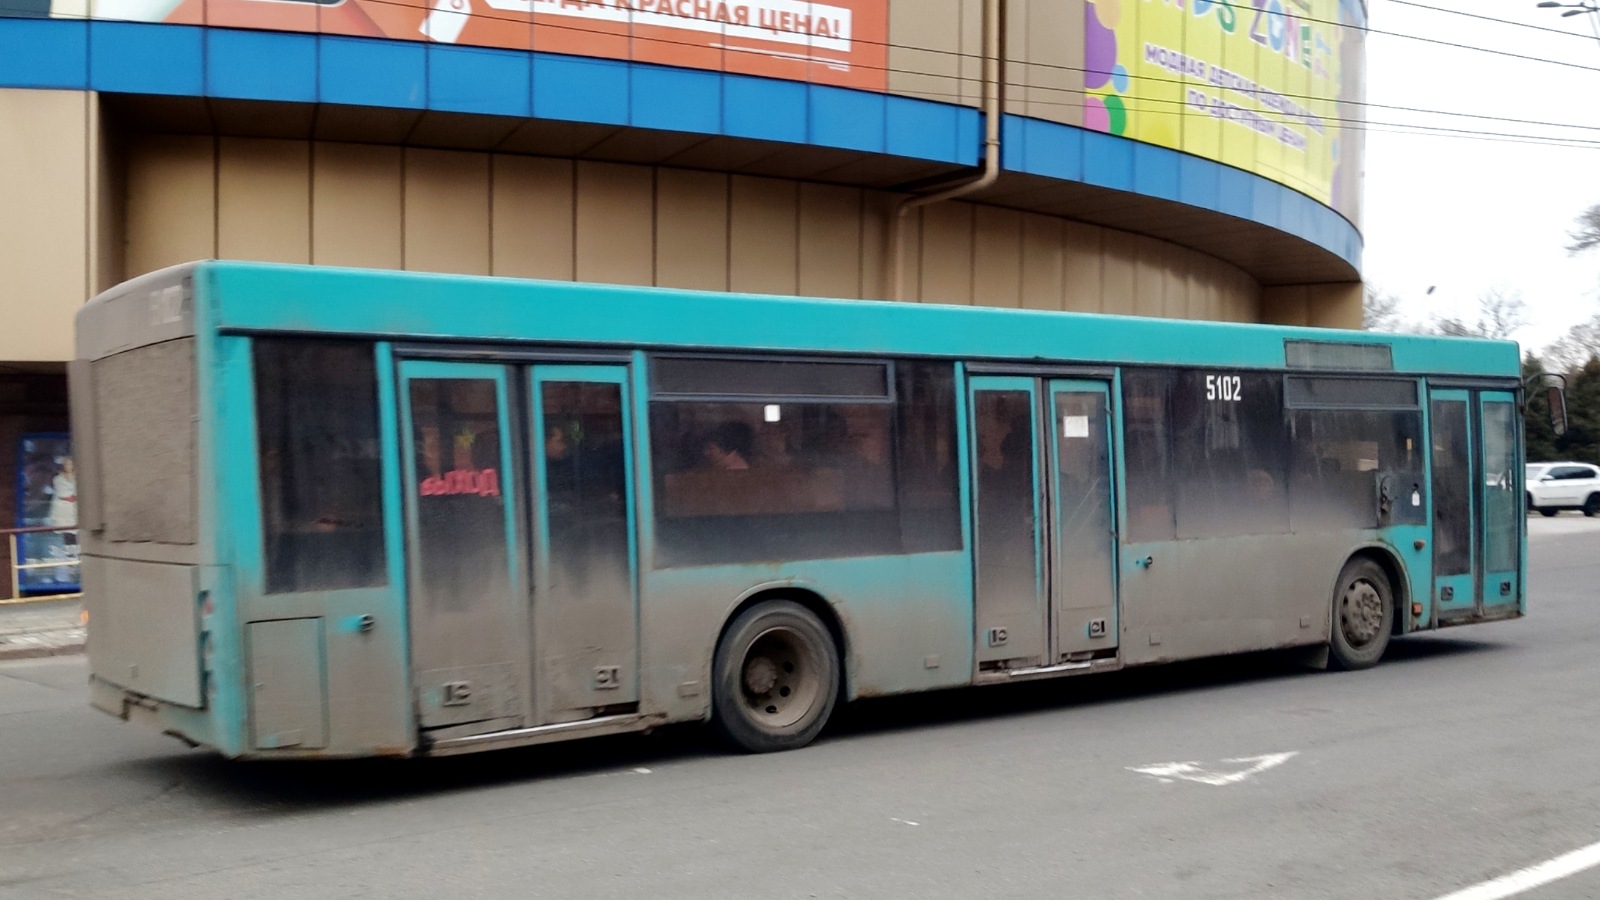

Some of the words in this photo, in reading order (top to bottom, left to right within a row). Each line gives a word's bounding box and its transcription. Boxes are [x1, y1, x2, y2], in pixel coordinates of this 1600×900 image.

[758, 7, 841, 39] ЦЕНА!
[1144, 42, 1205, 79] МОДНАЯ
[1187, 89, 1207, 111] ПО
[1206, 375, 1242, 401] 5102
